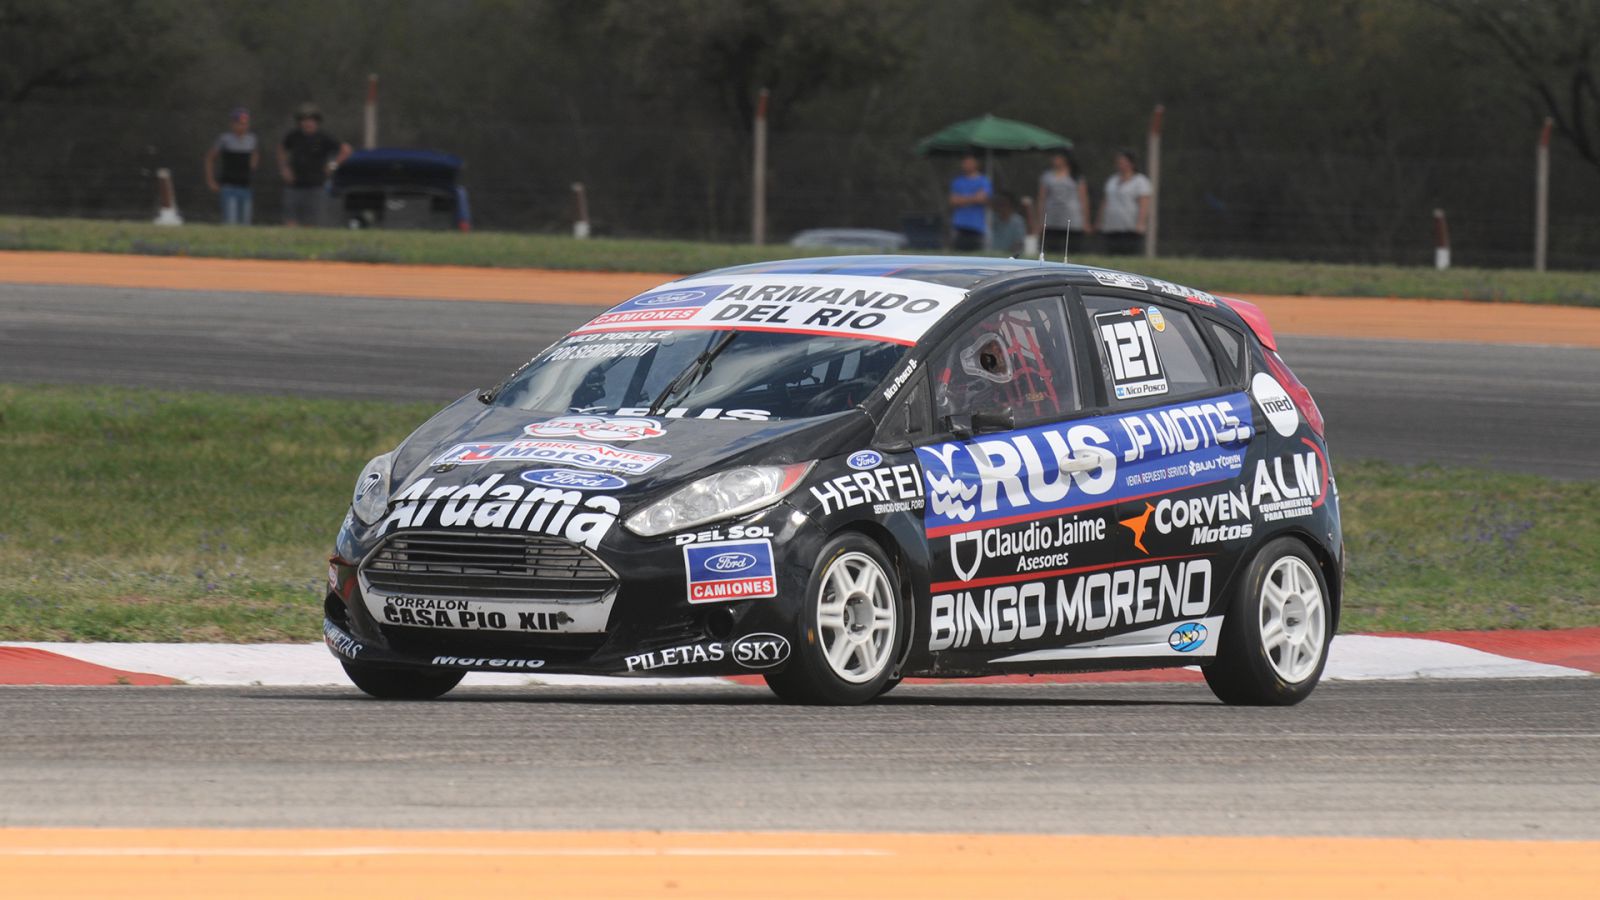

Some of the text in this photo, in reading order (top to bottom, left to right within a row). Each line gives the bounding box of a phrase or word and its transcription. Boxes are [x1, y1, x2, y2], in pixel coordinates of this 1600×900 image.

[716, 285, 940, 314] ARMANDO
[594, 309, 694, 324] CAMIONES
[711, 304, 886, 329] DEL RIO
[600, 331, 651, 341] POSCO
[543, 345, 579, 362] POR
[569, 343, 632, 360] SIEMPRE
[1101, 319, 1159, 380] 121
[883, 383, 899, 401] Nico
[894, 364, 914, 388] Posco
[1125, 384, 1166, 396] Nico Posco
[1262, 395, 1294, 414] med
[1118, 401, 1250, 462] JP MOTOS
[505, 446, 643, 470] Moreno
[514, 440, 657, 462] LUBRICANTES
[855, 454, 876, 467] Ford
[541, 471, 607, 487] Ford
[966, 425, 1116, 513] RUS
[1126, 474, 1141, 487] VENTA
[1141, 470, 1167, 484] REPUESTO
[1167, 464, 1188, 478] SERVICIO
[1196, 459, 1216, 473] BAJAJ
[1252, 452, 1320, 506] ALM
[810, 464, 924, 515] HERFEI
[376, 474, 621, 551] Ardama
[911, 499, 925, 510] FORD
[1154, 484, 1251, 534] CORVEN
[1264, 506, 1313, 522] PARA TALLERES
[675, 525, 774, 546] DEL SOL
[984, 515, 1106, 558] Claudio Jaime
[1191, 523, 1253, 545] Motos
[716, 555, 747, 570] Ford
[1016, 552, 1069, 572] Asesores
[693, 580, 771, 598] CAMIONES
[385, 596, 469, 611] CORRALON
[928, 559, 1212, 651] BINGO MORENO
[383, 605, 455, 628] CASA
[458, 610, 507, 629] PIO
[431, 655, 546, 669] Moreno
[624, 643, 725, 672] PILETAS
[737, 641, 785, 661] SKY
